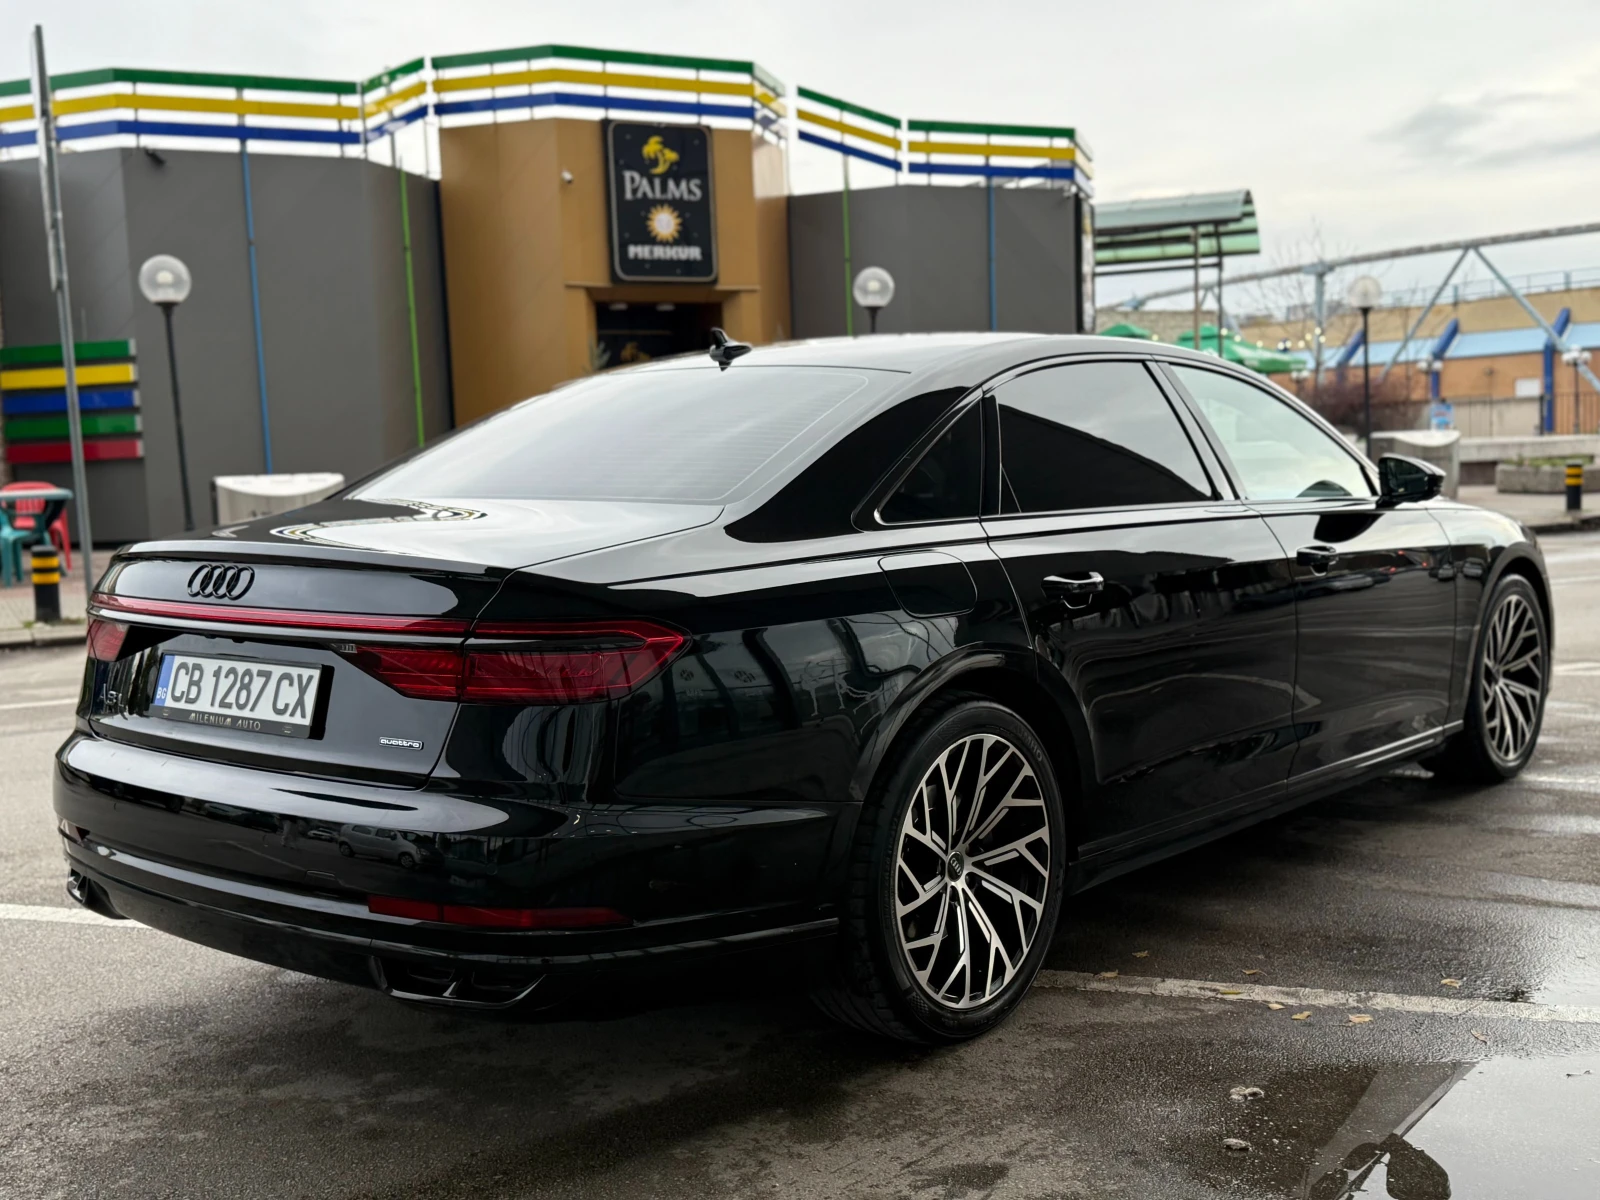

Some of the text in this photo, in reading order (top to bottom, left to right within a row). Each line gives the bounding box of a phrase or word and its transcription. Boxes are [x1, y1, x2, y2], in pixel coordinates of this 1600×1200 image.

[622, 170, 702, 201] PALMS
[627, 244, 702, 261] MERKUR
[156, 687, 168, 699] BG
[170, 661, 314, 719] CB 1287 CX
[188, 712, 261, 731] MILENIUM AUTO
[380, 738, 420, 748] quattro
